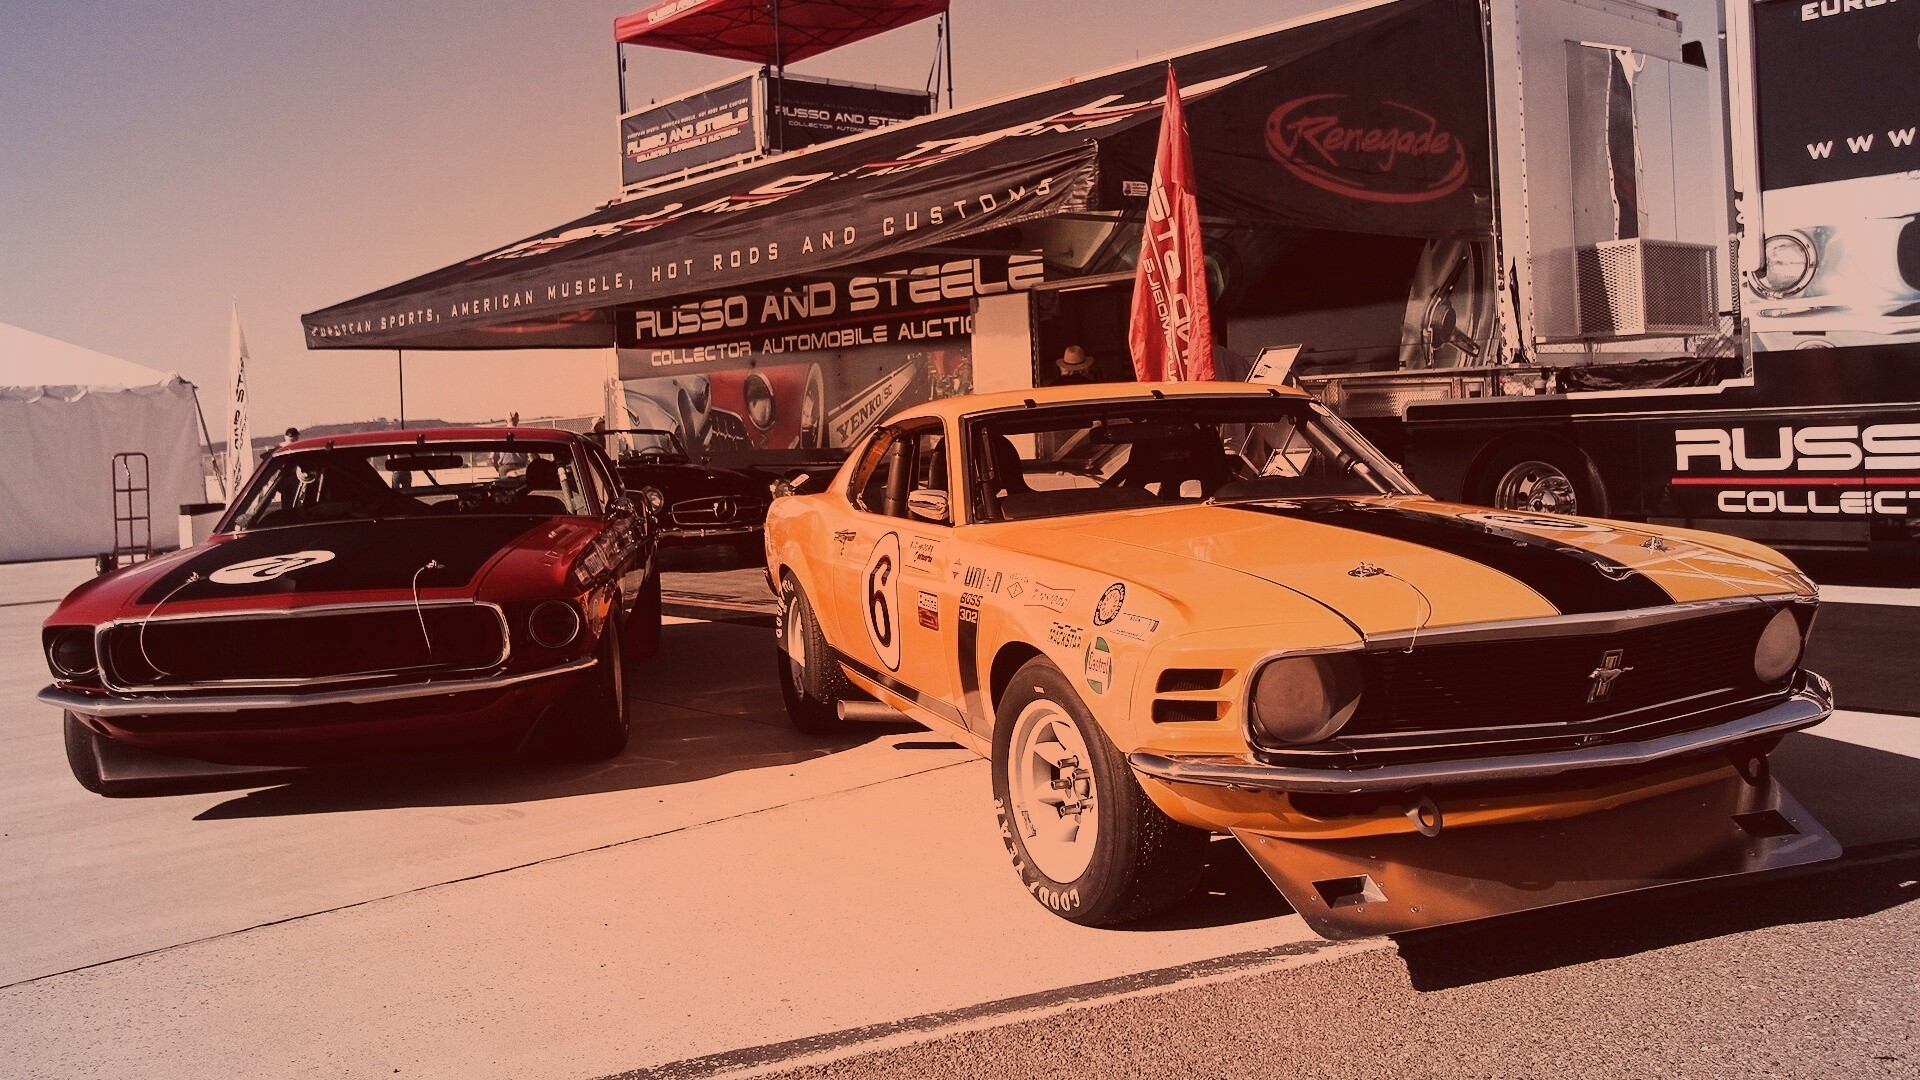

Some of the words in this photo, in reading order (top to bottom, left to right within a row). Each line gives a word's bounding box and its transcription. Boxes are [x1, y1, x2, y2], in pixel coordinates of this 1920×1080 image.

[835, 112, 865, 125] AND
[1288, 116, 1450, 172] Renegade
[451, 290, 534, 318] AMERICAN
[547, 272, 634, 300] MUSCLE,
[651, 258, 693, 283] HOT
[713, 242, 779, 271] RODS
[802, 226, 856, 253] AND
[883, 178, 1052, 236] CUSTOMS
[636, 294, 748, 341] RUSSO
[761, 281, 836, 325] AND
[850, 254, 1045, 312] STEELE
[651, 340, 752, 367] COLLECTOR
[762, 324, 888, 355] AUTOMOBILE
[1675, 423, 1920, 471] RUSS
[868, 554, 892, 648] 6
[960, 592, 984, 608] BOSS
[964, 565, 1003, 594] UNIN
[959, 608, 979, 624] 302
[1088, 651, 1109, 675] Castrol
